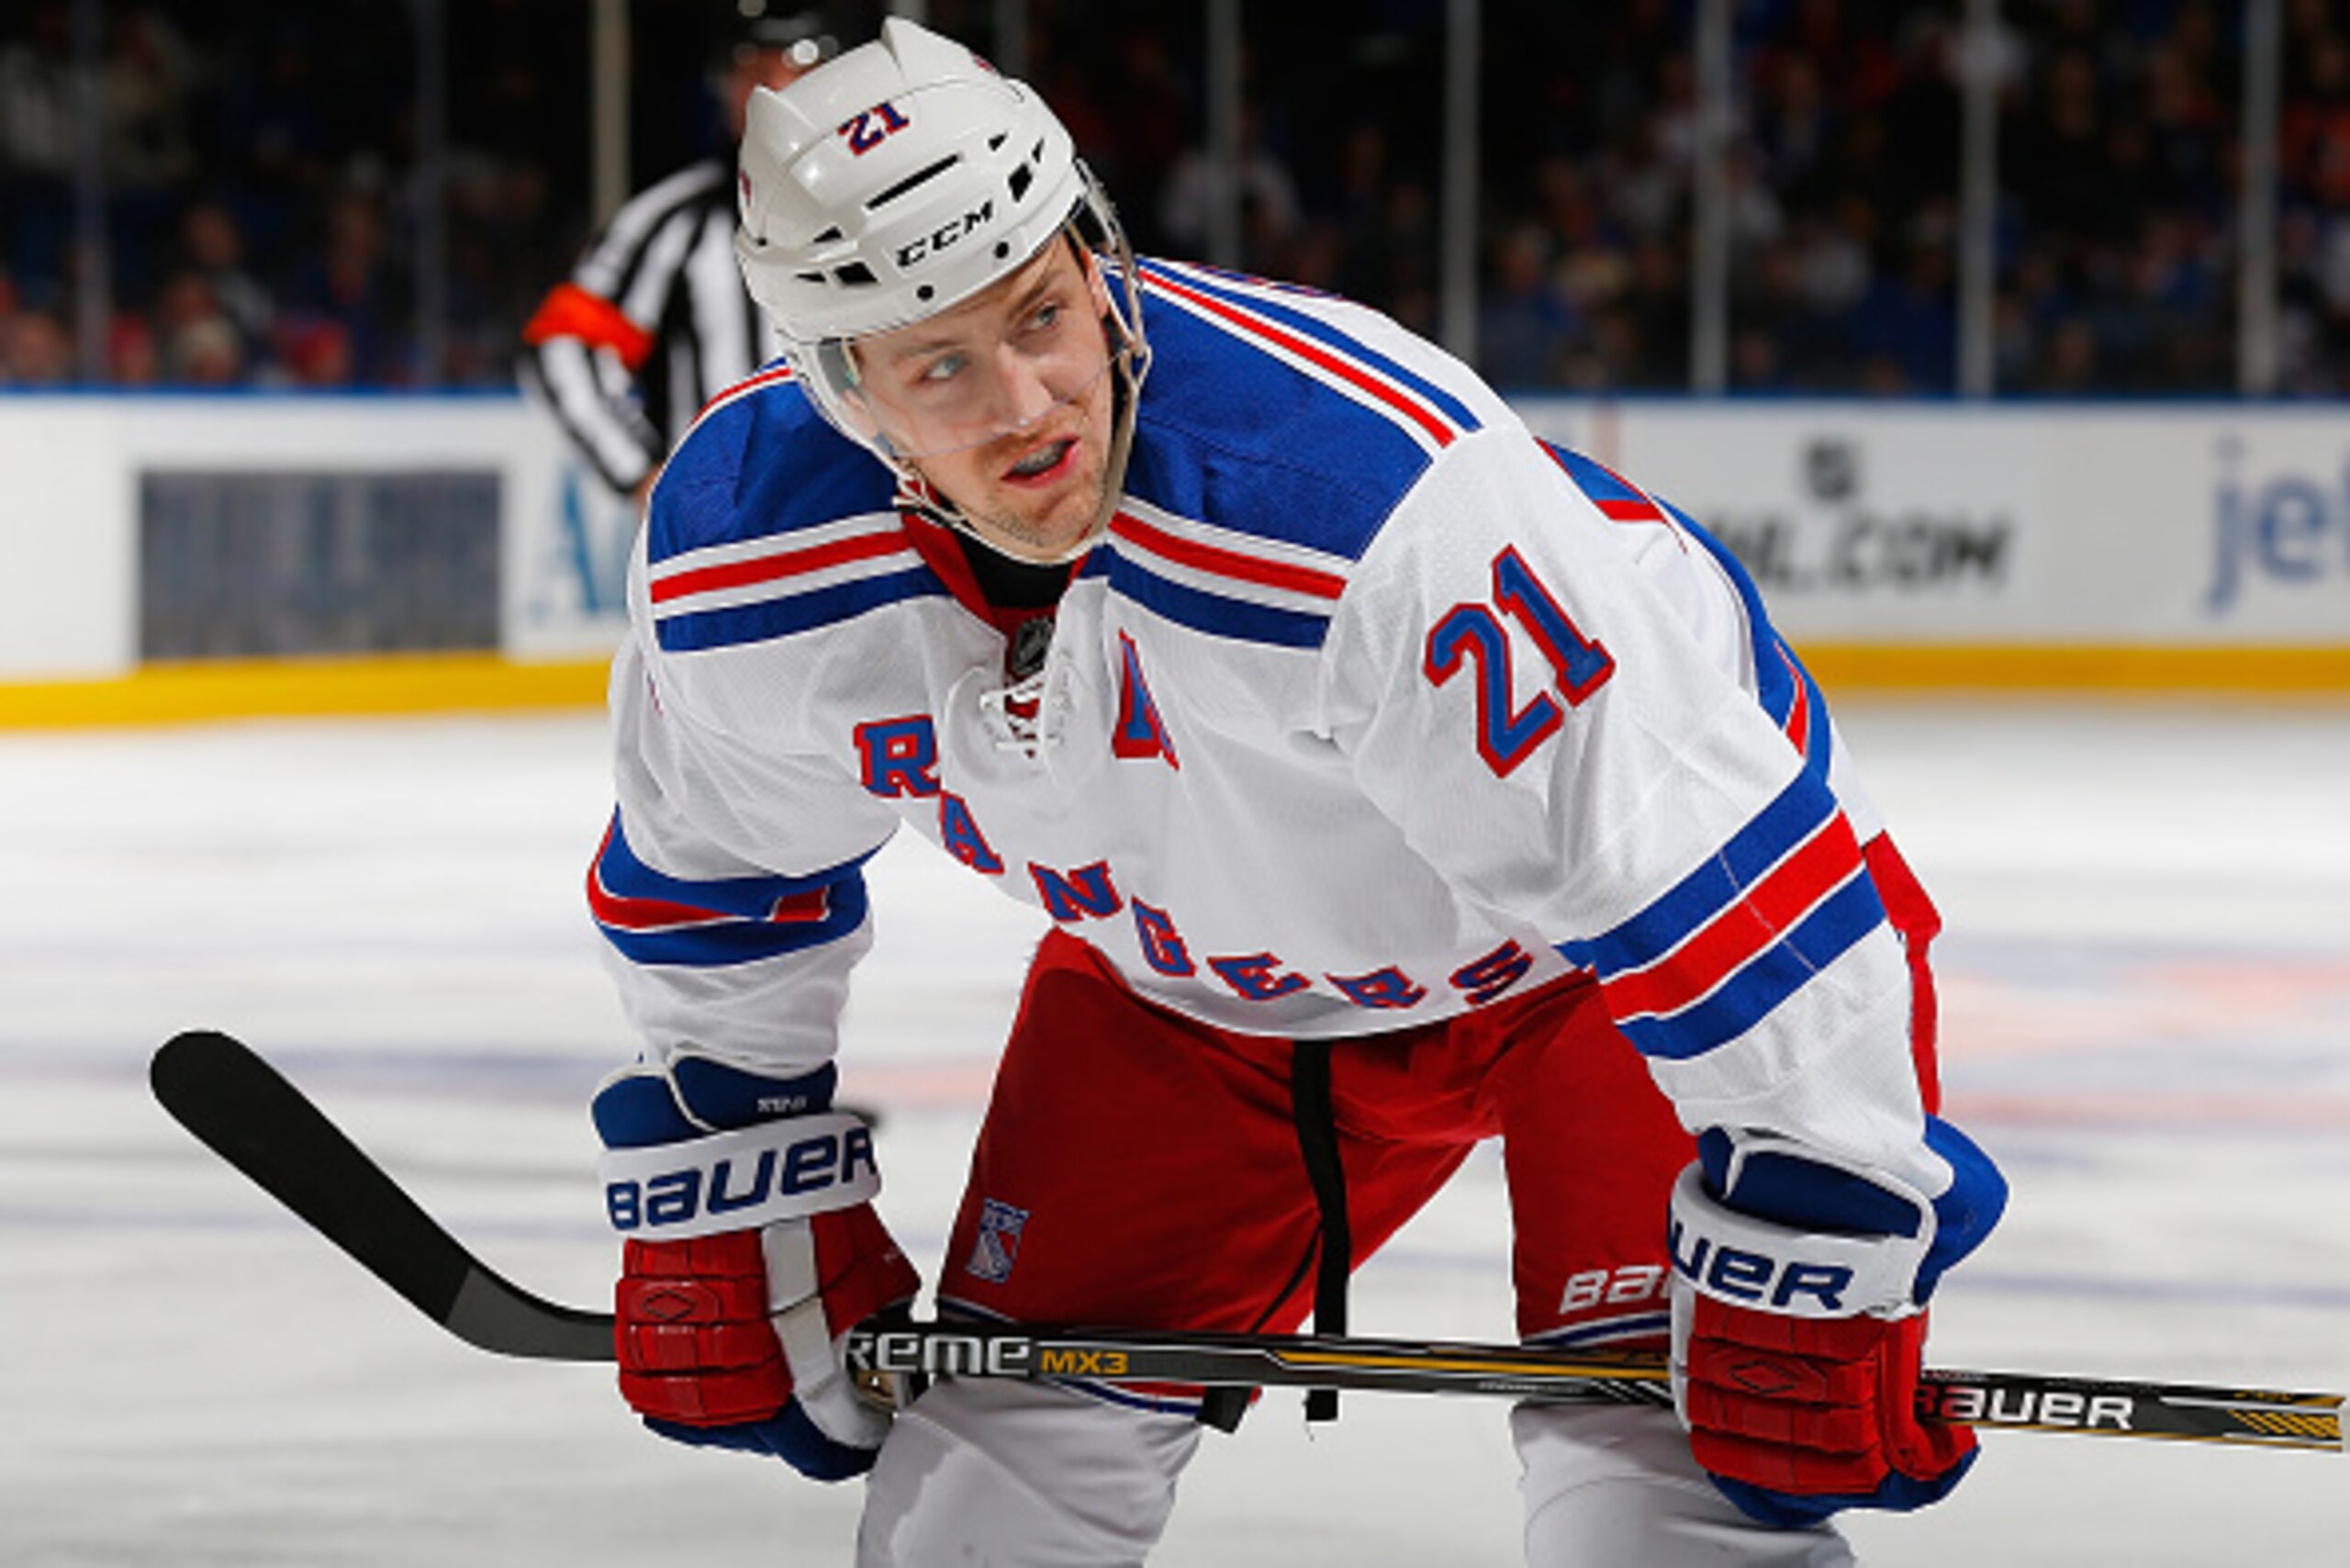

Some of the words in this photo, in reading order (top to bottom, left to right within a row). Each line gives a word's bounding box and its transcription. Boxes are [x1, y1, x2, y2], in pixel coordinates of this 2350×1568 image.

[836, 101, 910, 157] 21
[896, 200, 994, 268] CCM
[2199, 436, 2350, 617] je
[1422, 543, 1616, 779] 21
[853, 714, 1535, 1006] RANGERS
[1559, 1264, 1672, 1315] BA
[1669, 1220, 1854, 1310] UER
[1041, 1350, 1129, 1374] MX3
